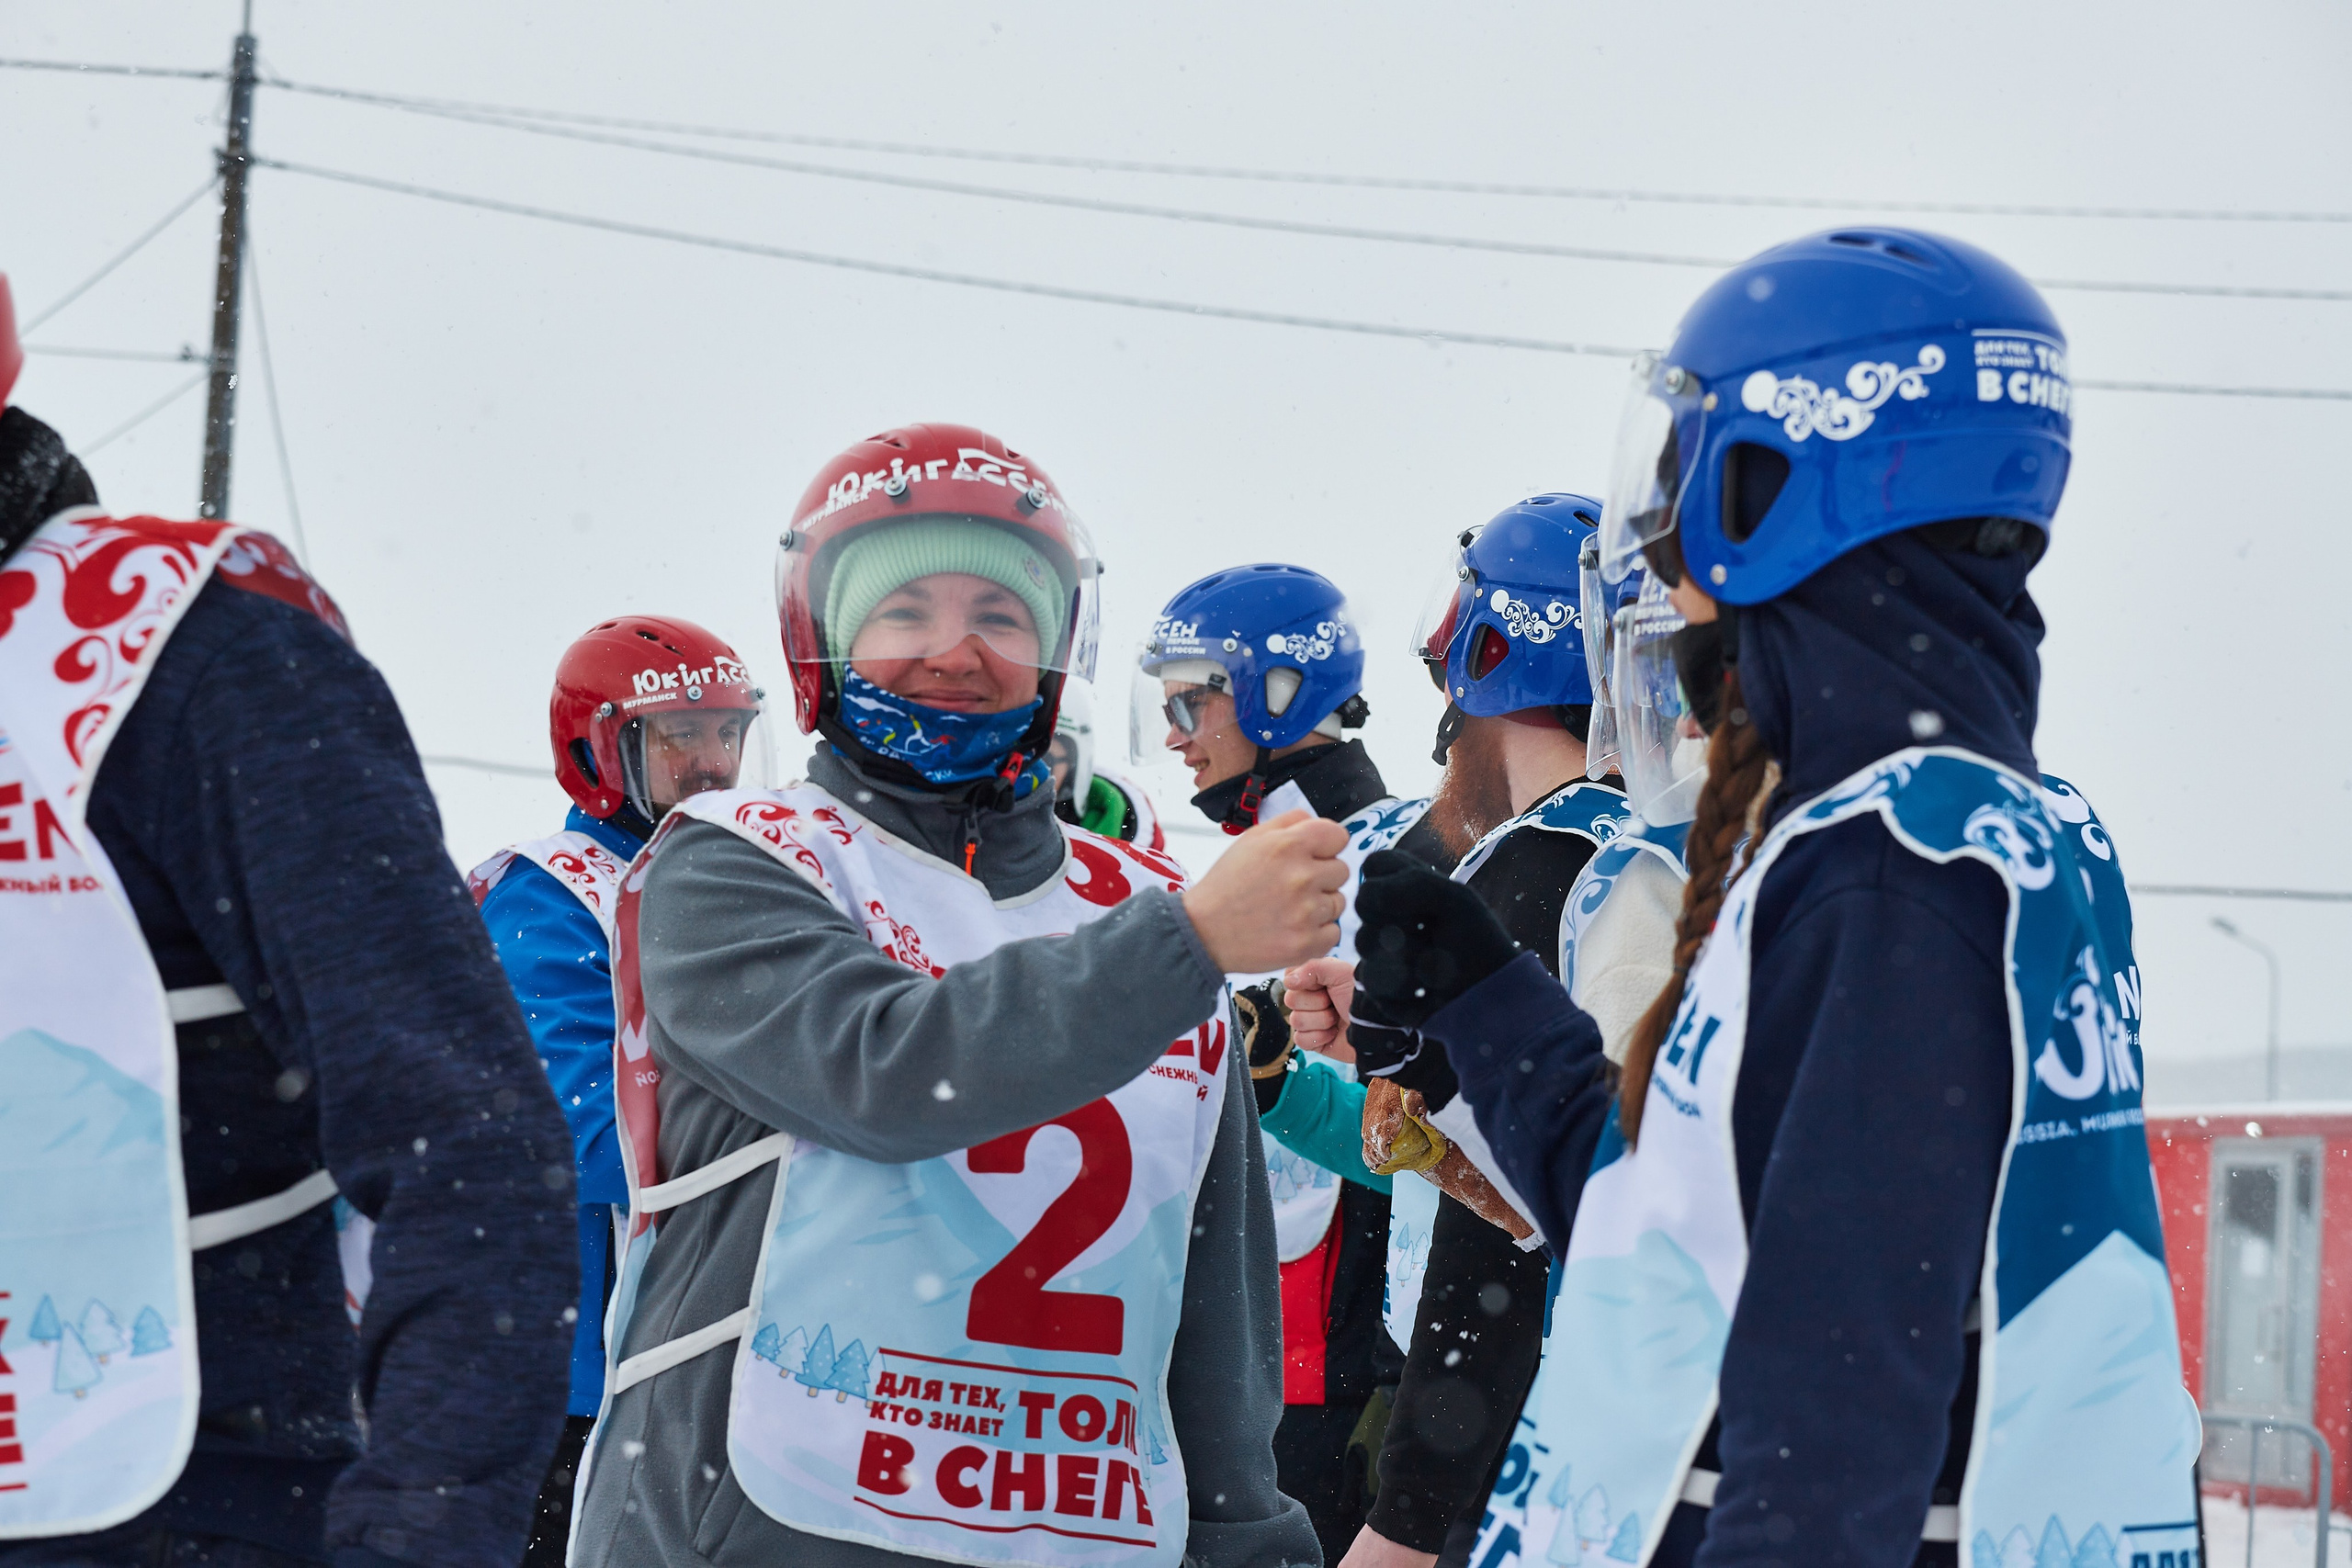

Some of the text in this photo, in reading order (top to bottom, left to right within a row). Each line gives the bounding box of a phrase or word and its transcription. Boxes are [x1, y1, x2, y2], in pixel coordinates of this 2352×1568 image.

[1976, 367, 2004, 402] В
[1171, 647, 1206, 655] РОССИИ
[622, 692, 677, 710] МУРМАНСК
[967, 1095, 1133, 1356] 2
[876, 1371, 1006, 1413] ДЛЯ ТЕХ,
[869, 1400, 1004, 1437] КТО ЗНАЕТ
[857, 1429, 916, 1495] В
